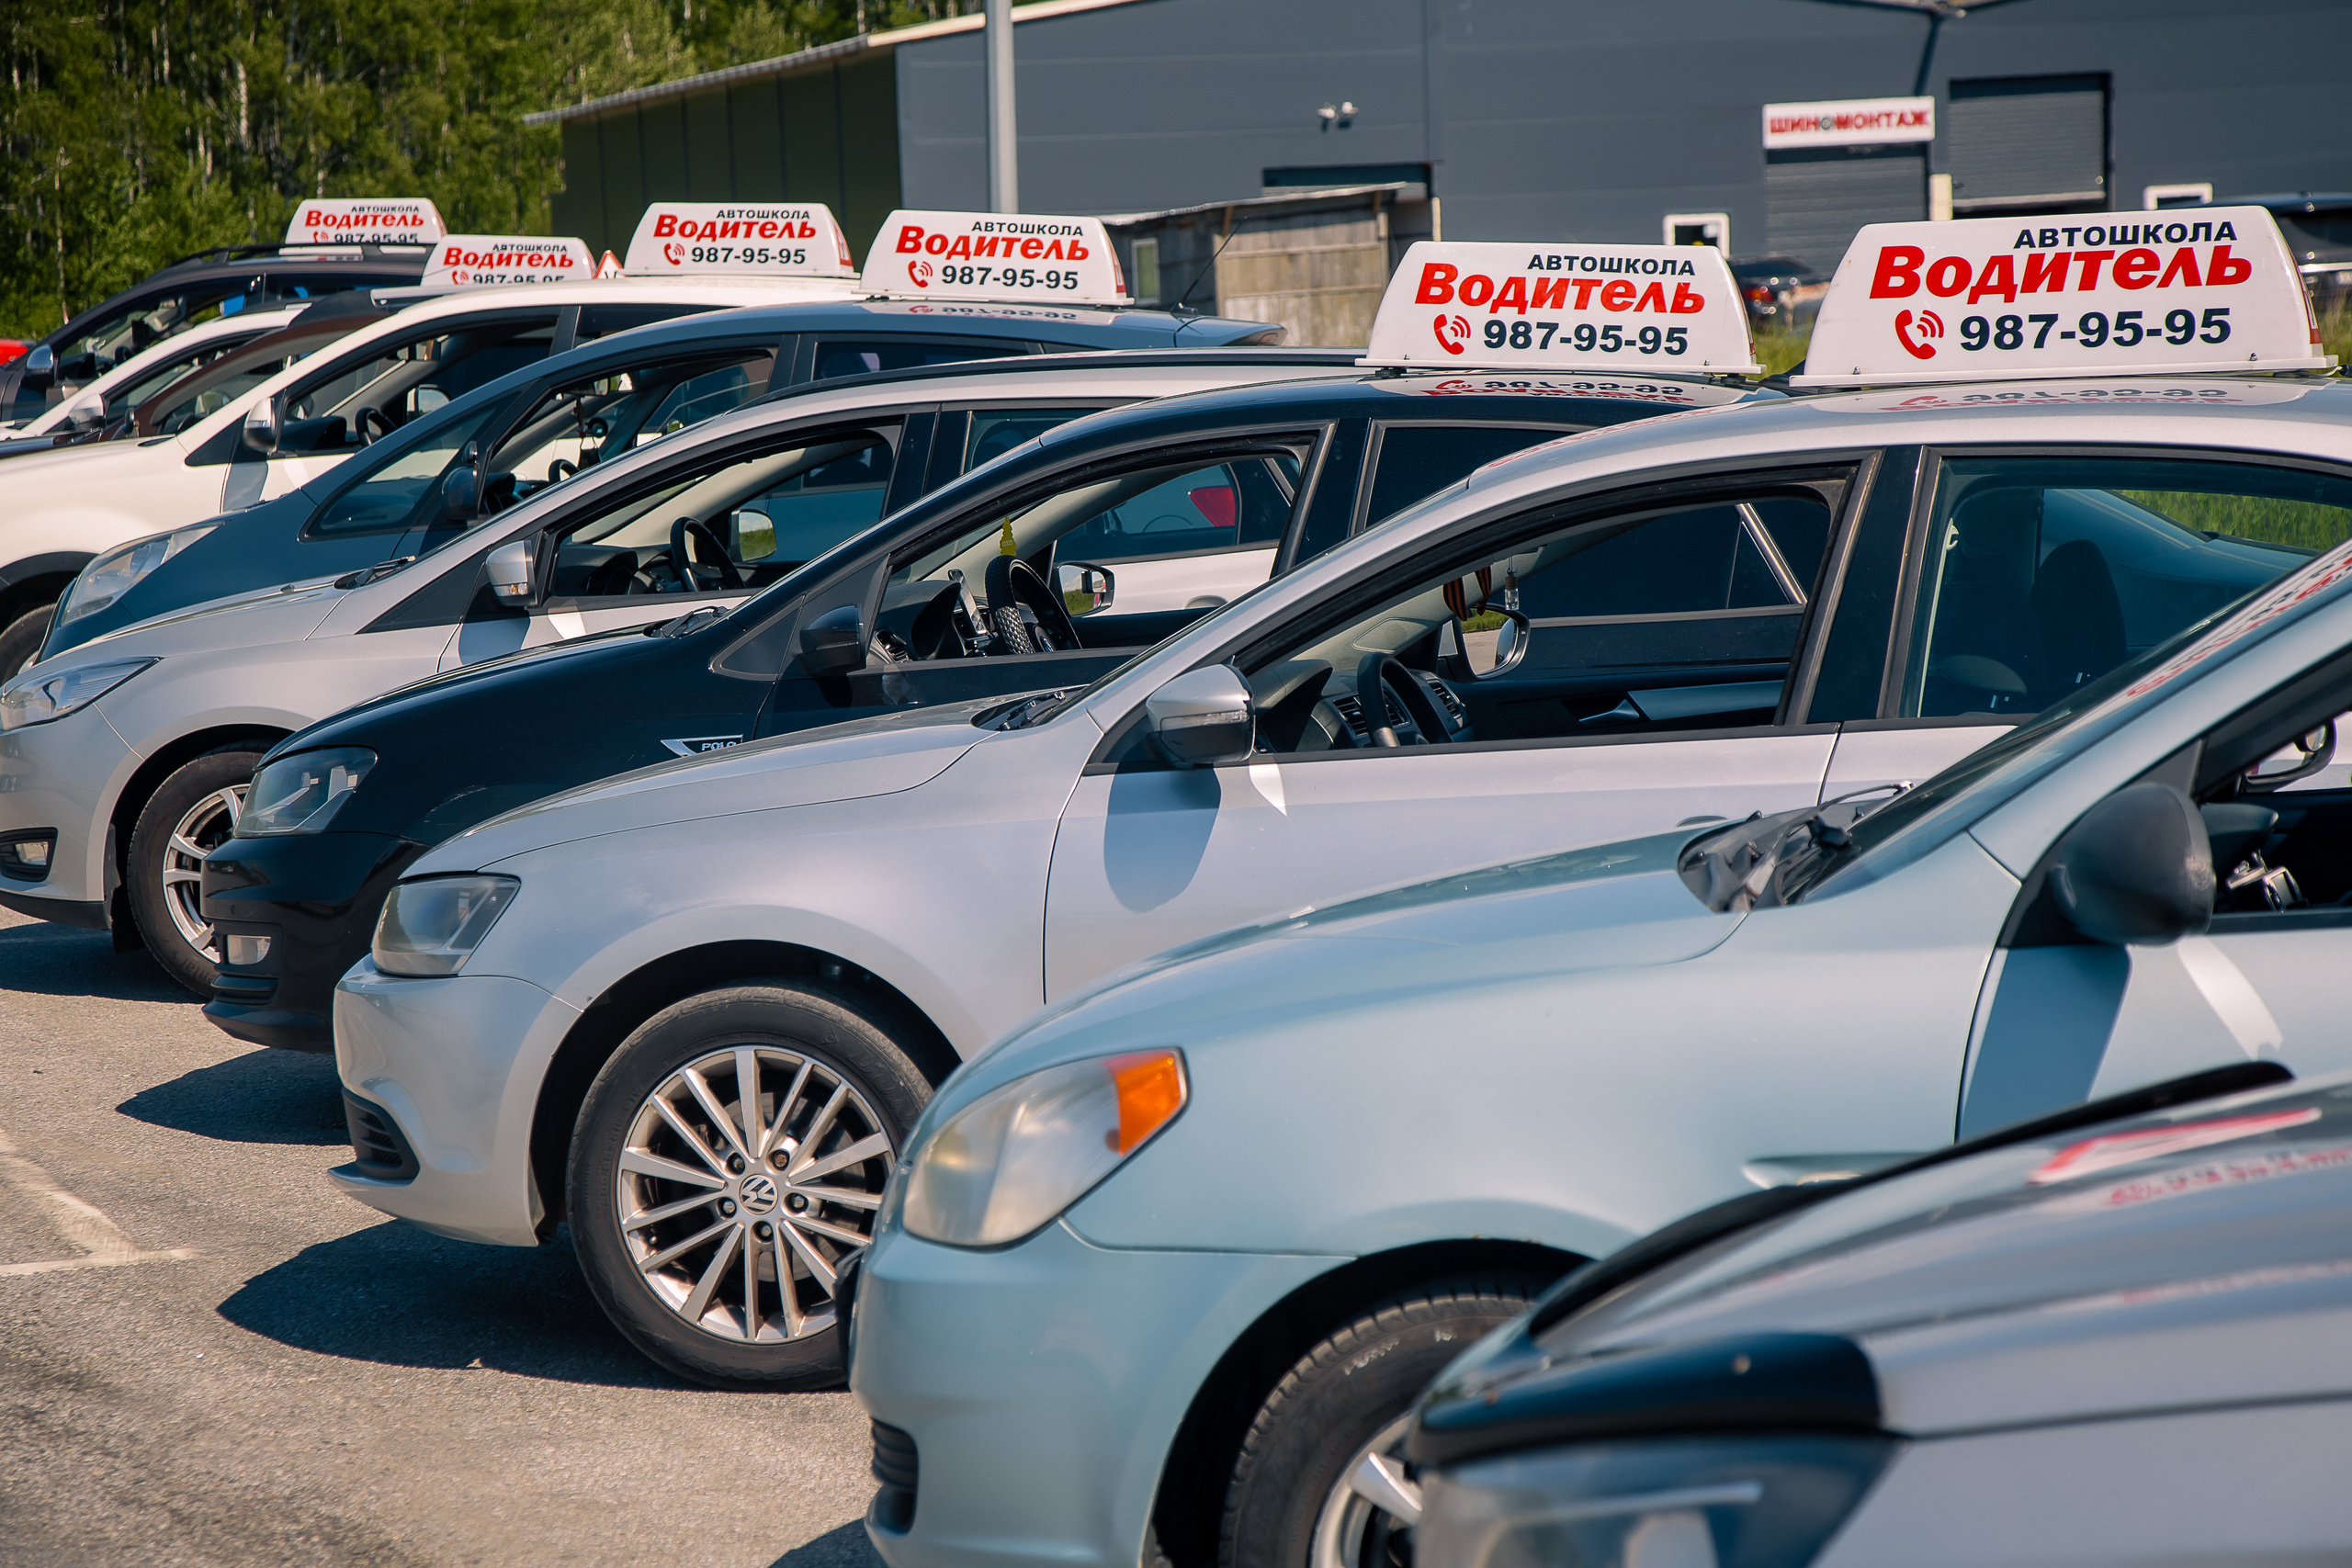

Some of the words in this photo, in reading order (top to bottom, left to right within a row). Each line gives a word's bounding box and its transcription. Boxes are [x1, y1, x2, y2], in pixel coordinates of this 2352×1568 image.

[305, 209, 424, 230] Водитель
[716, 209, 810, 220] АВТОШКОЛА
[653, 213, 817, 242] Водитель
[971, 221, 1083, 237] АВТОШКОЛА
[2013, 220, 2238, 250] АВТОШКОЛА
[492, 243, 567, 252] АВТОШКОЛА
[691, 246, 806, 265] 987-95-95
[896, 225, 1089, 262] Водитель
[443, 247, 573, 270] Водитель
[1527, 254, 1696, 276] АВТОШКОЛА
[942, 265, 1079, 290] 987-95-95
[1869, 245, 2253, 305] Водитель
[1414, 263, 1706, 315] Водитель
[1483, 319, 1689, 355] 987-95-95
[1960, 307, 2231, 352] 987-95-95
